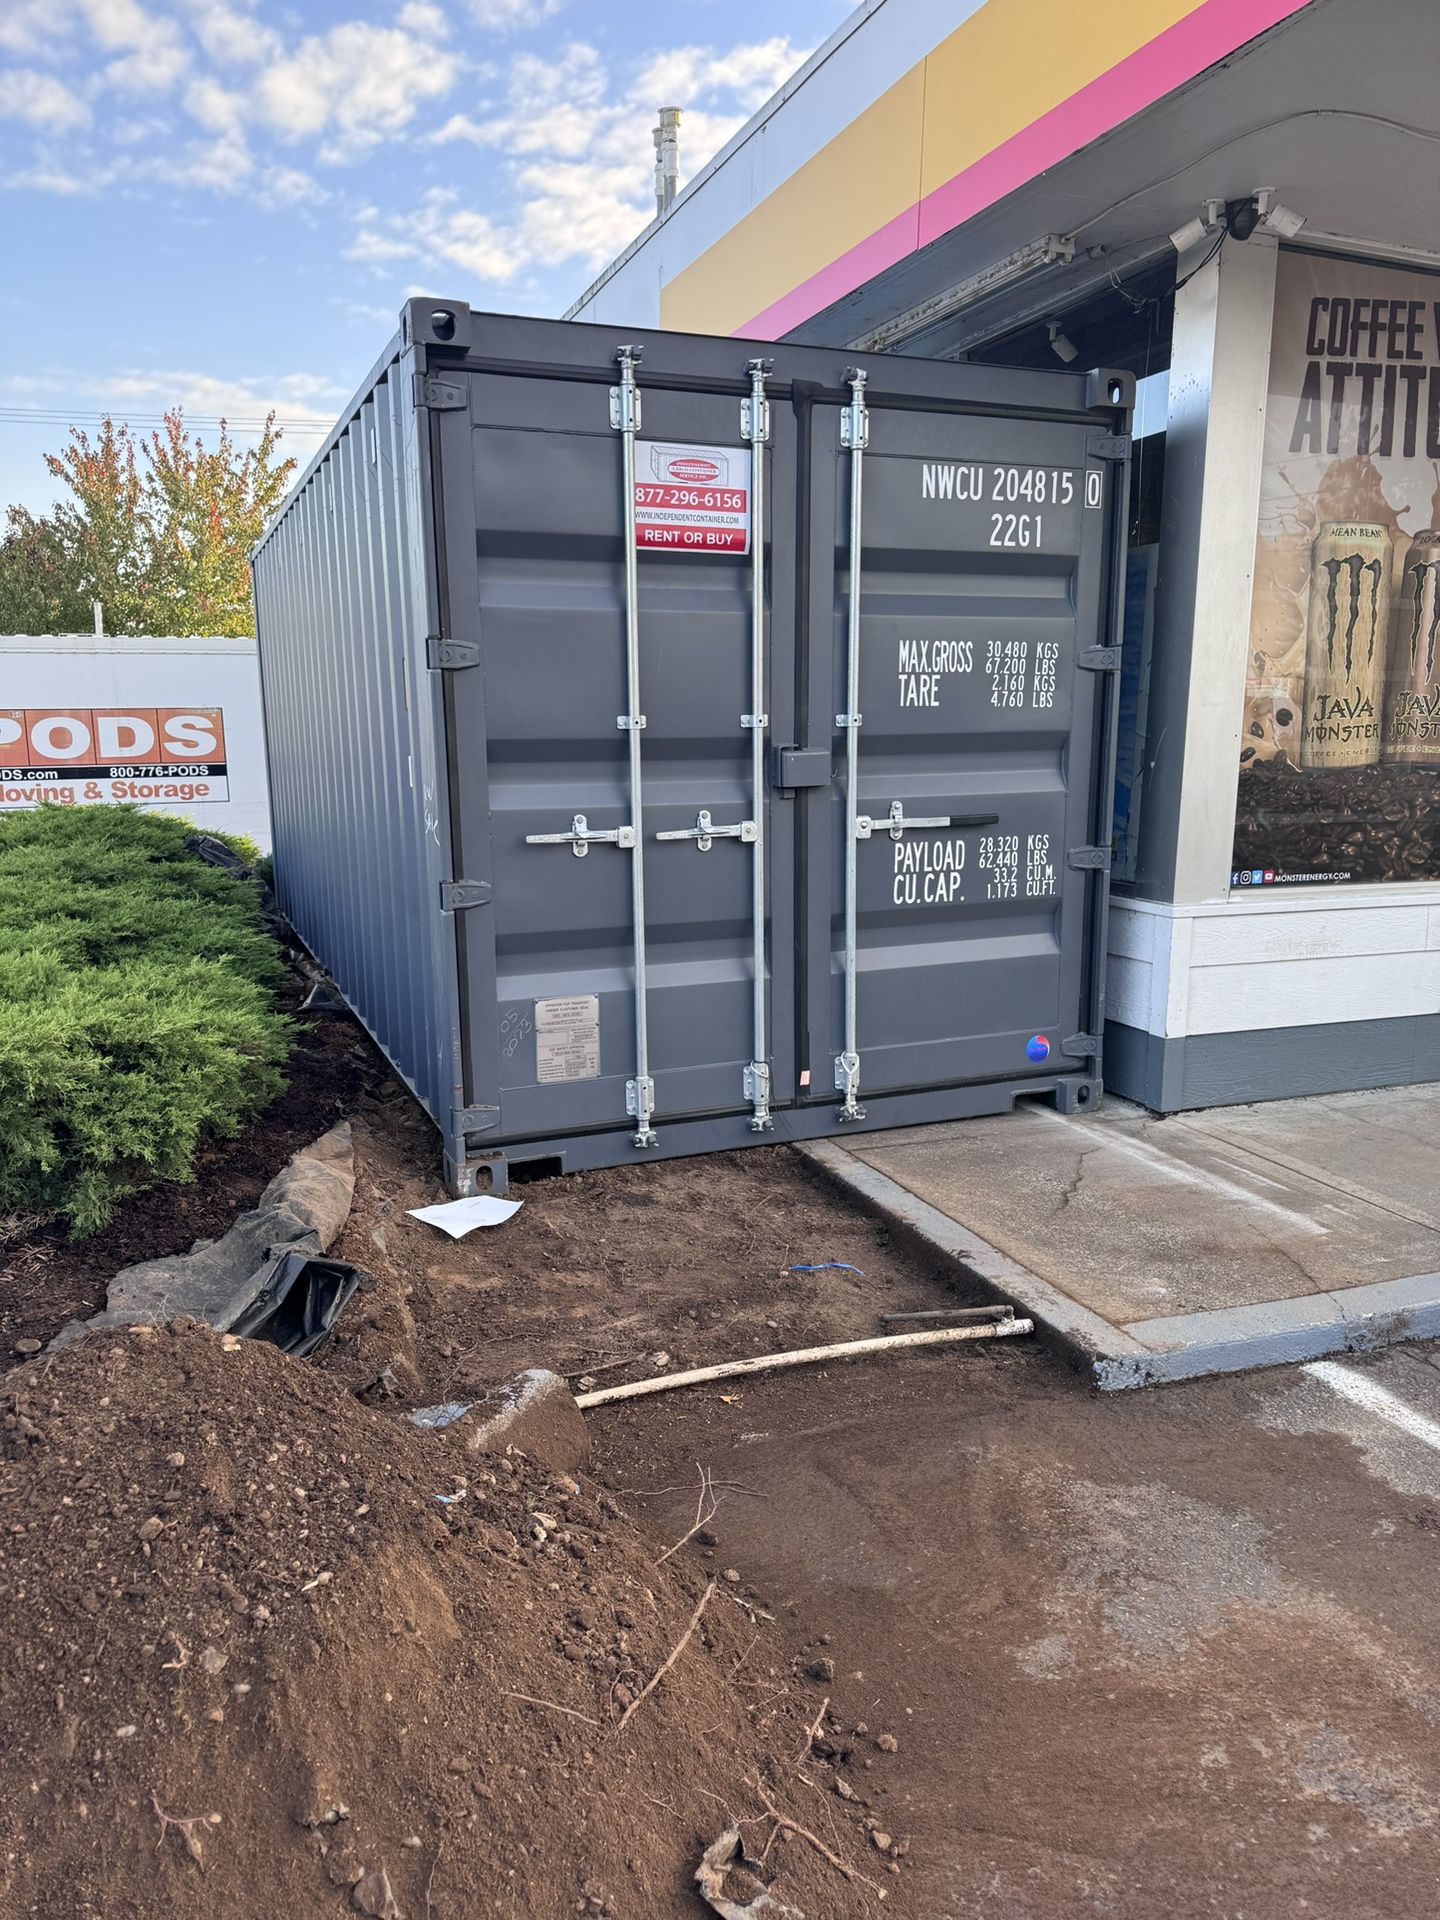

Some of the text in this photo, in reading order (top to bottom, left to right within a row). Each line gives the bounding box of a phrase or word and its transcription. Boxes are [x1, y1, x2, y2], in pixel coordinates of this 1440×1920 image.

[1306, 298, 1426, 360] COFFEE
[922, 464, 1100, 506] NWCU 204815 0
[636, 488, 742, 508] 877-296-6156
[645, 530, 734, 545] RENT OR BUY
[990, 513, 1042, 548] 22G1
[1330, 528, 1357, 537] MEAN
[898, 640, 974, 672] MAX.GROSS
[987, 641, 1058, 658] 30,480 KGS
[986, 658, 1056, 675] 67,200 LBS
[898, 674, 940, 707] TARE
[992, 674, 1056, 692] 2,160 KGS
[990, 691, 1053, 708] 4,760 LBS
[1314, 686, 1374, 721] JAVA
[1396, 685, 1440, 719] JAV
[1305, 722, 1378, 744] MONSTER
[0, 766, 209, 780] DS.com 800-776-PODS
[0, 780, 210, 804] oving & Storage
[1028, 834, 1049, 850] KGS
[894, 840, 966, 873] PAYLOAD
[1027, 850, 1047, 866] LBS
[994, 864, 1056, 882] 33.2 CU.M.
[1274, 872, 1350, 882] MONSTERENERGY.COM
[894, 872, 964, 904] CU.CAP.
[1026, 880, 1056, 896] CU.FT.
